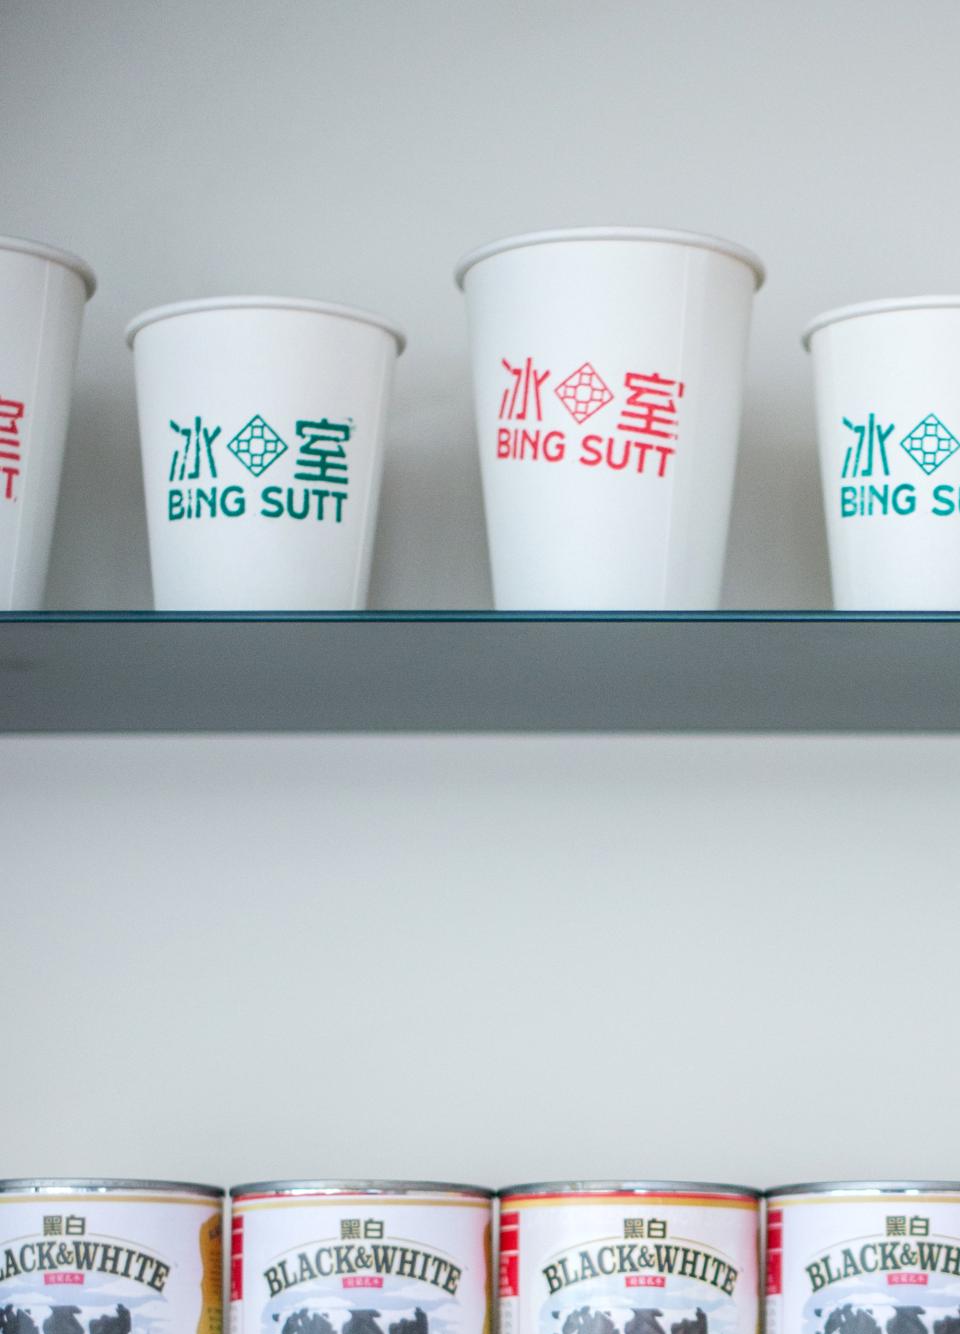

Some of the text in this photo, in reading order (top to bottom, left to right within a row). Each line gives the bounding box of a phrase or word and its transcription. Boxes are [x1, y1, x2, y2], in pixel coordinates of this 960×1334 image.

[497, 427, 675, 477] BING SUTT
[168, 486, 348, 523] BING SUTT
[840, 483, 916, 518] BING
[43, 1214, 86, 1236] 黑白
[340, 1218, 384, 1240] 黑白
[624, 1218, 667, 1239] 黑白
[886, 1215, 930, 1237] 黑白
[0, 1240, 171, 1293] ACK&WHITE
